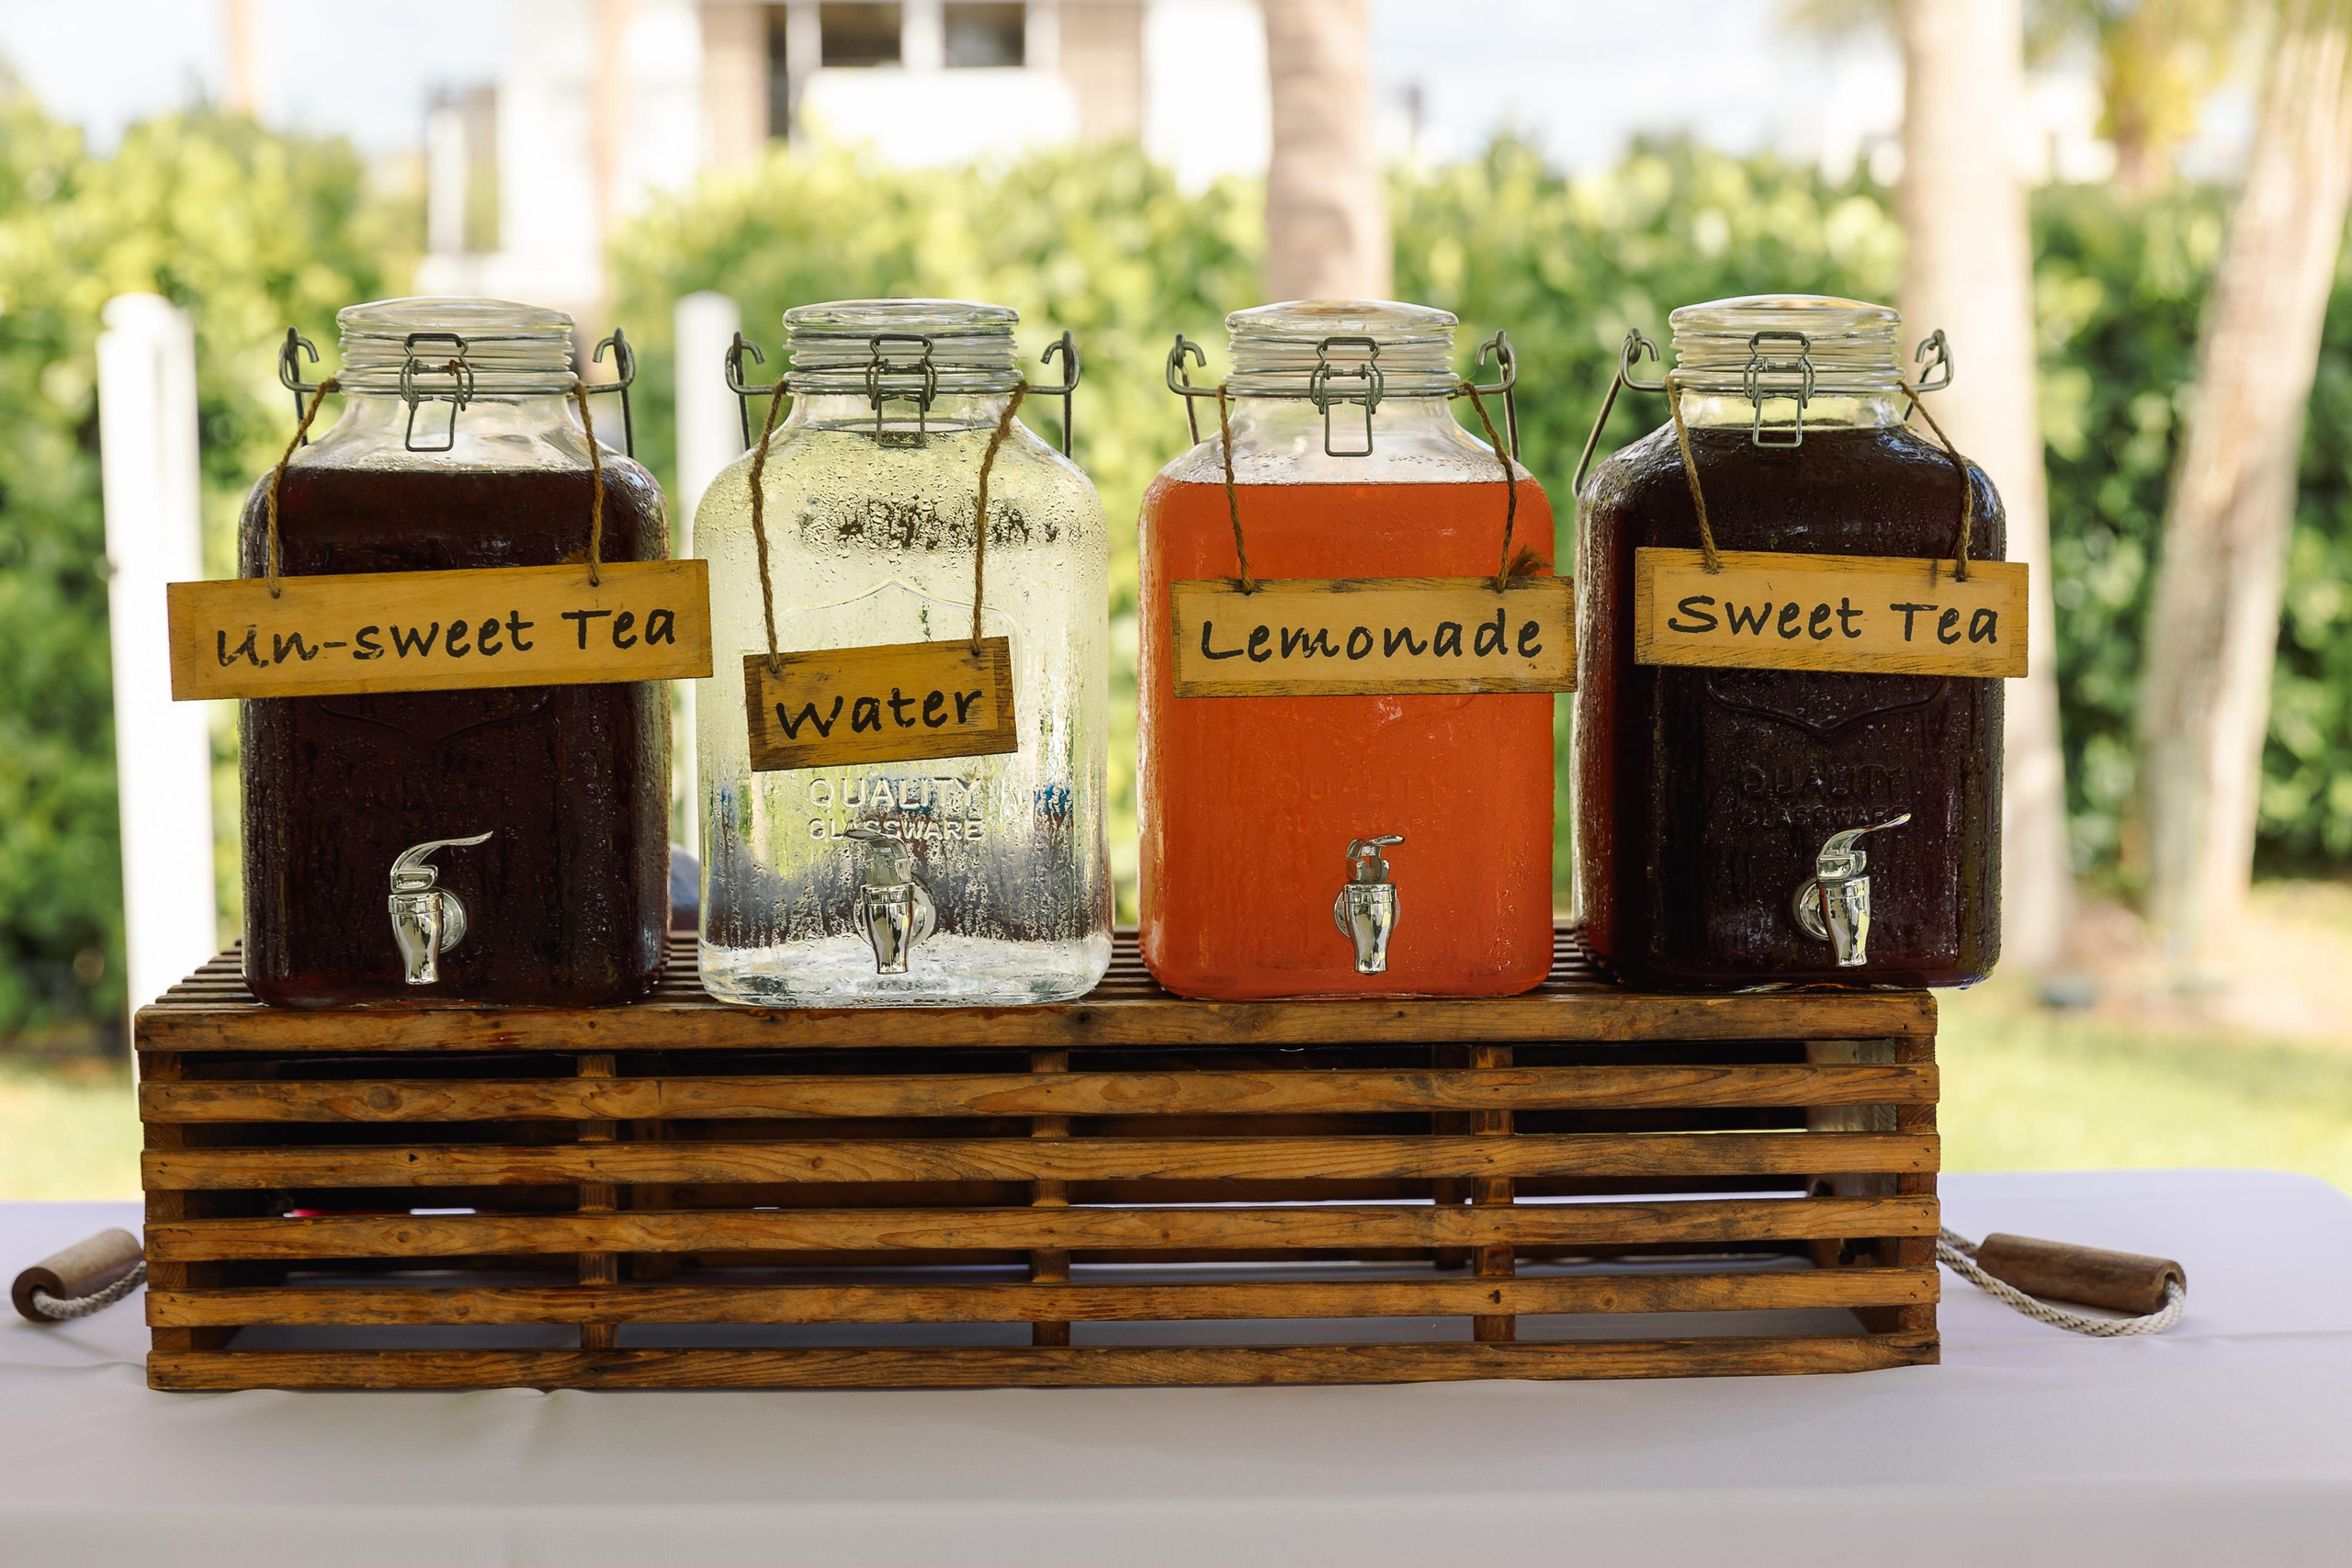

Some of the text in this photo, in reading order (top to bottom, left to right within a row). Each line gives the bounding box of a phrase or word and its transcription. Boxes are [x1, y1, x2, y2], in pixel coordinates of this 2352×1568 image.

[216, 608, 675, 669] Un-sweet Tea
[1201, 607, 1544, 663] Lemonade
[1668, 595, 1999, 645] Sweet Tea
[808, 778, 981, 808] QUALITY
